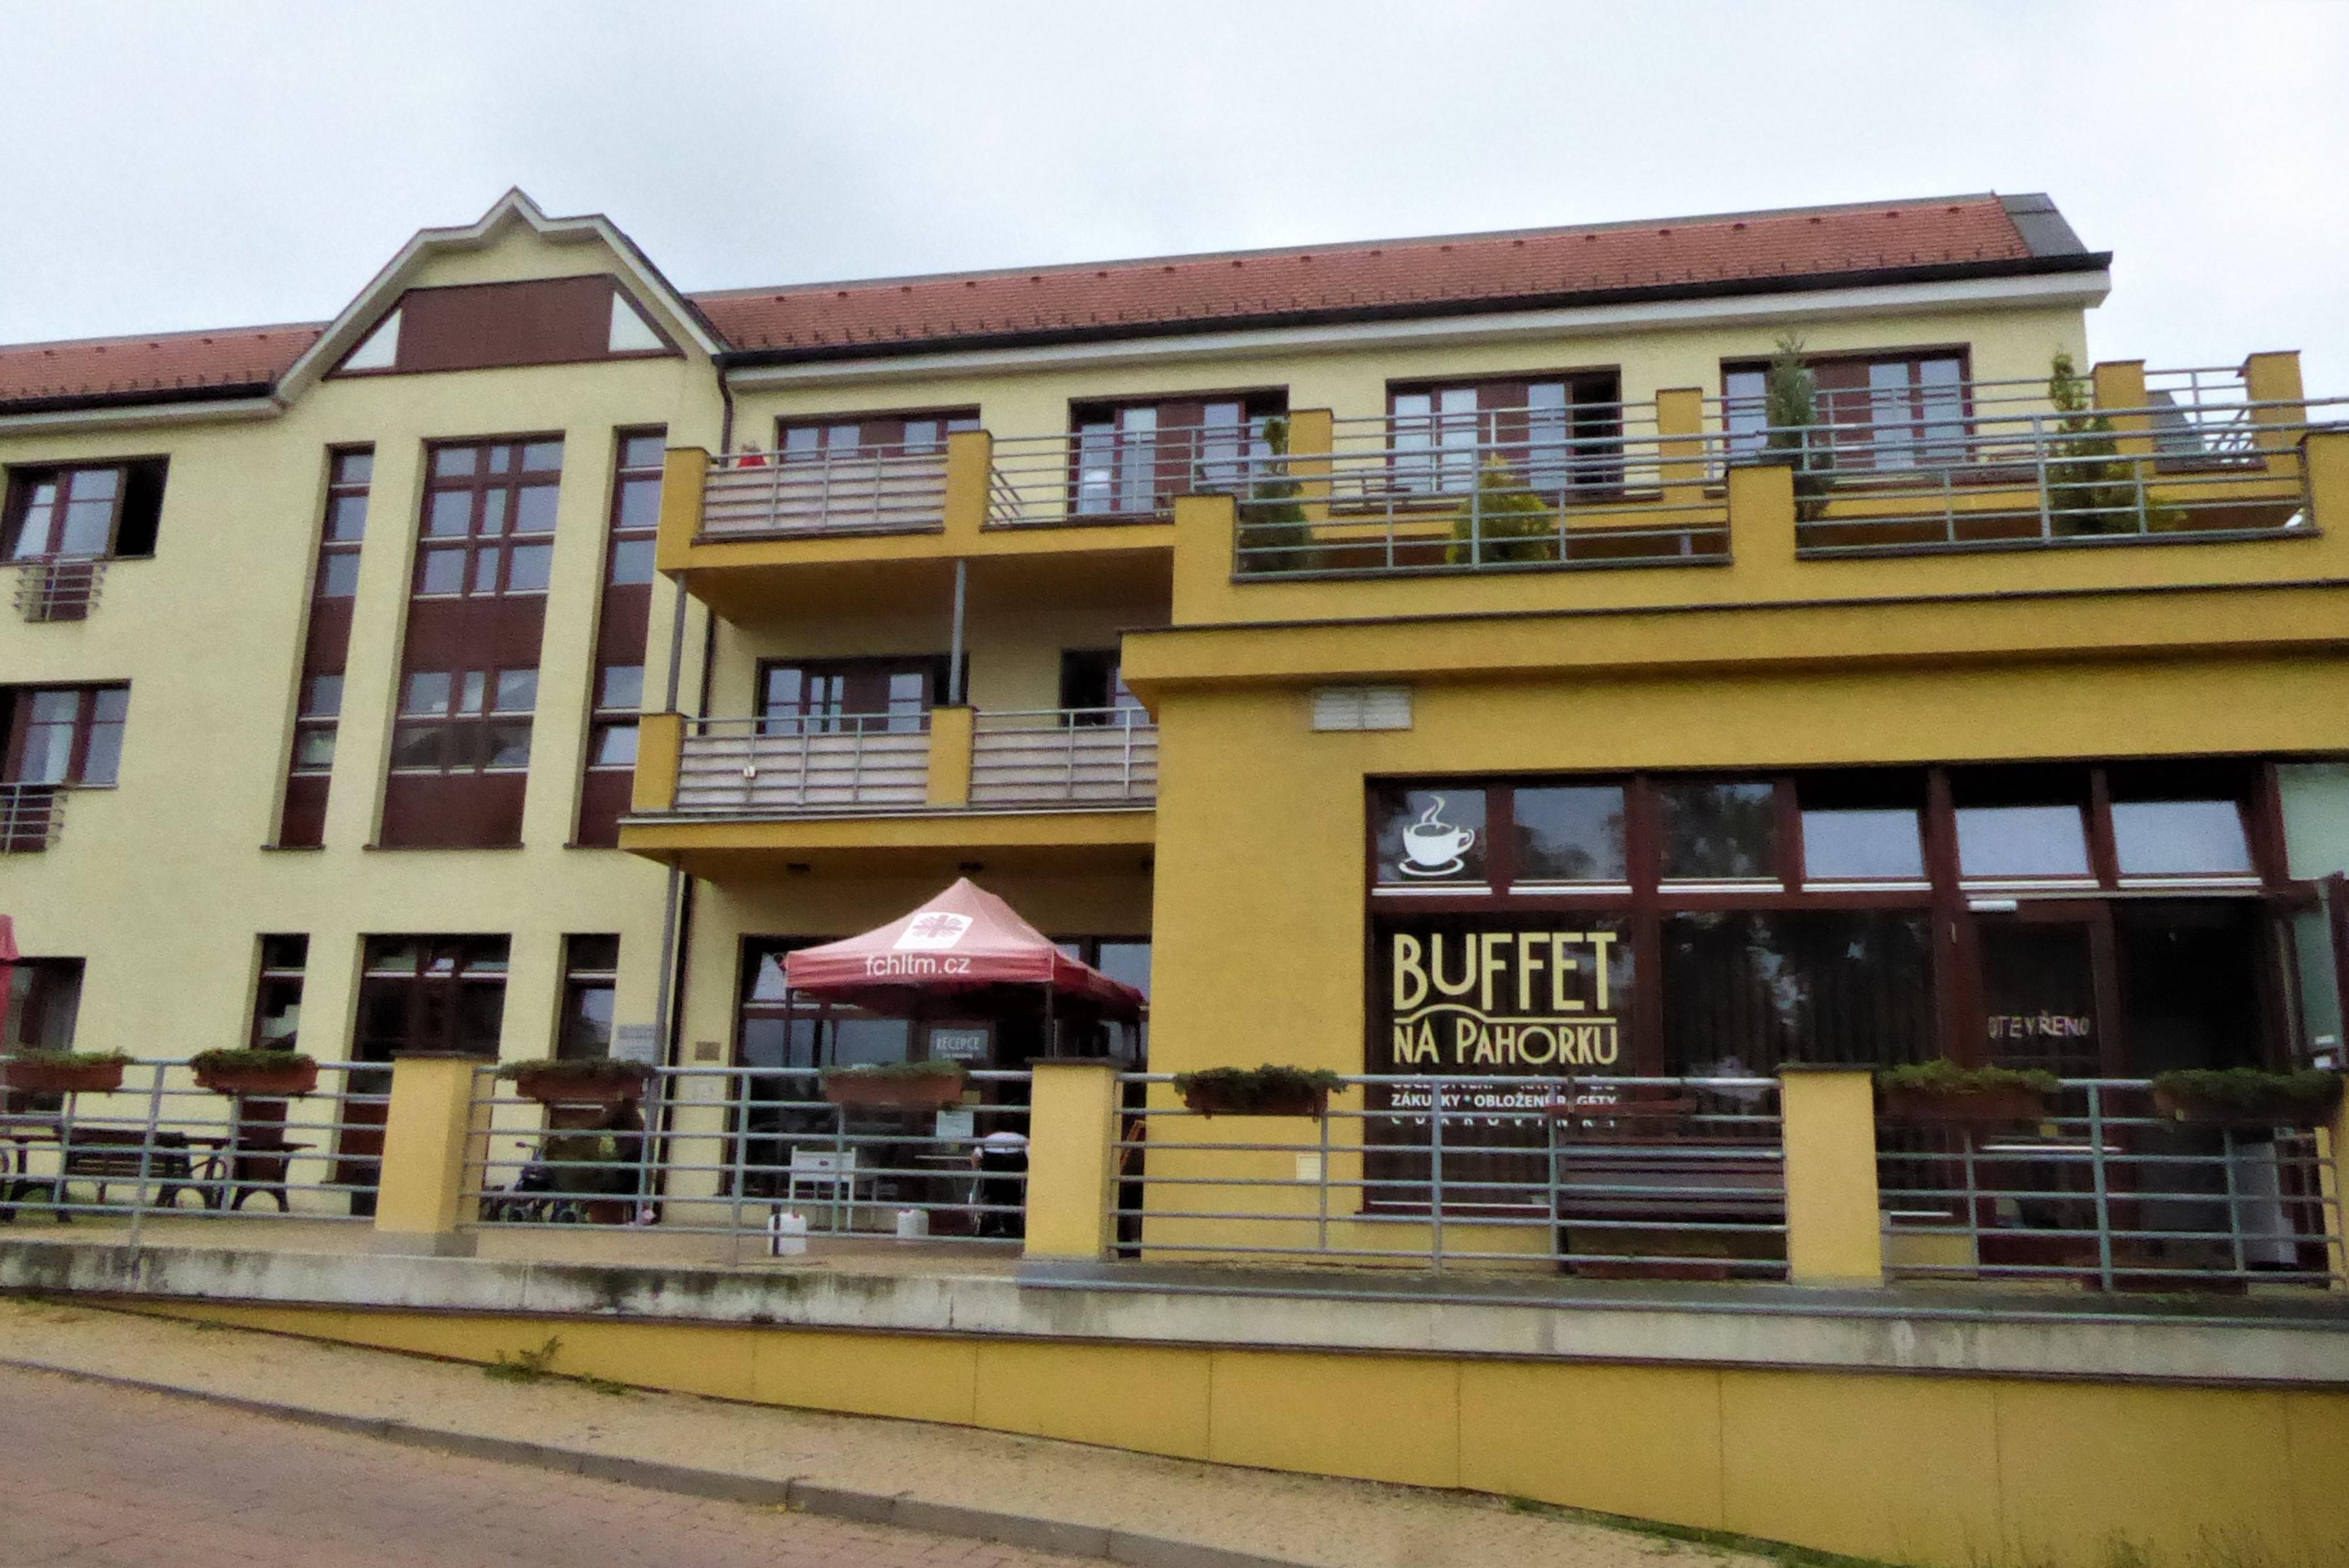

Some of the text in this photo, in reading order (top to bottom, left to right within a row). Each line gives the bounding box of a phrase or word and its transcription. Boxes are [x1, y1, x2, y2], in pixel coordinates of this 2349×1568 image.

[866, 954, 971, 975] fchltm.cz
[1393, 932, 1617, 1011] BUFFET
[1393, 1016, 1618, 1064] NA PAHORKU
[1391, 1090, 1460, 1107] ZÁKUKY
[1556, 1095, 1617, 1106] BGETY
